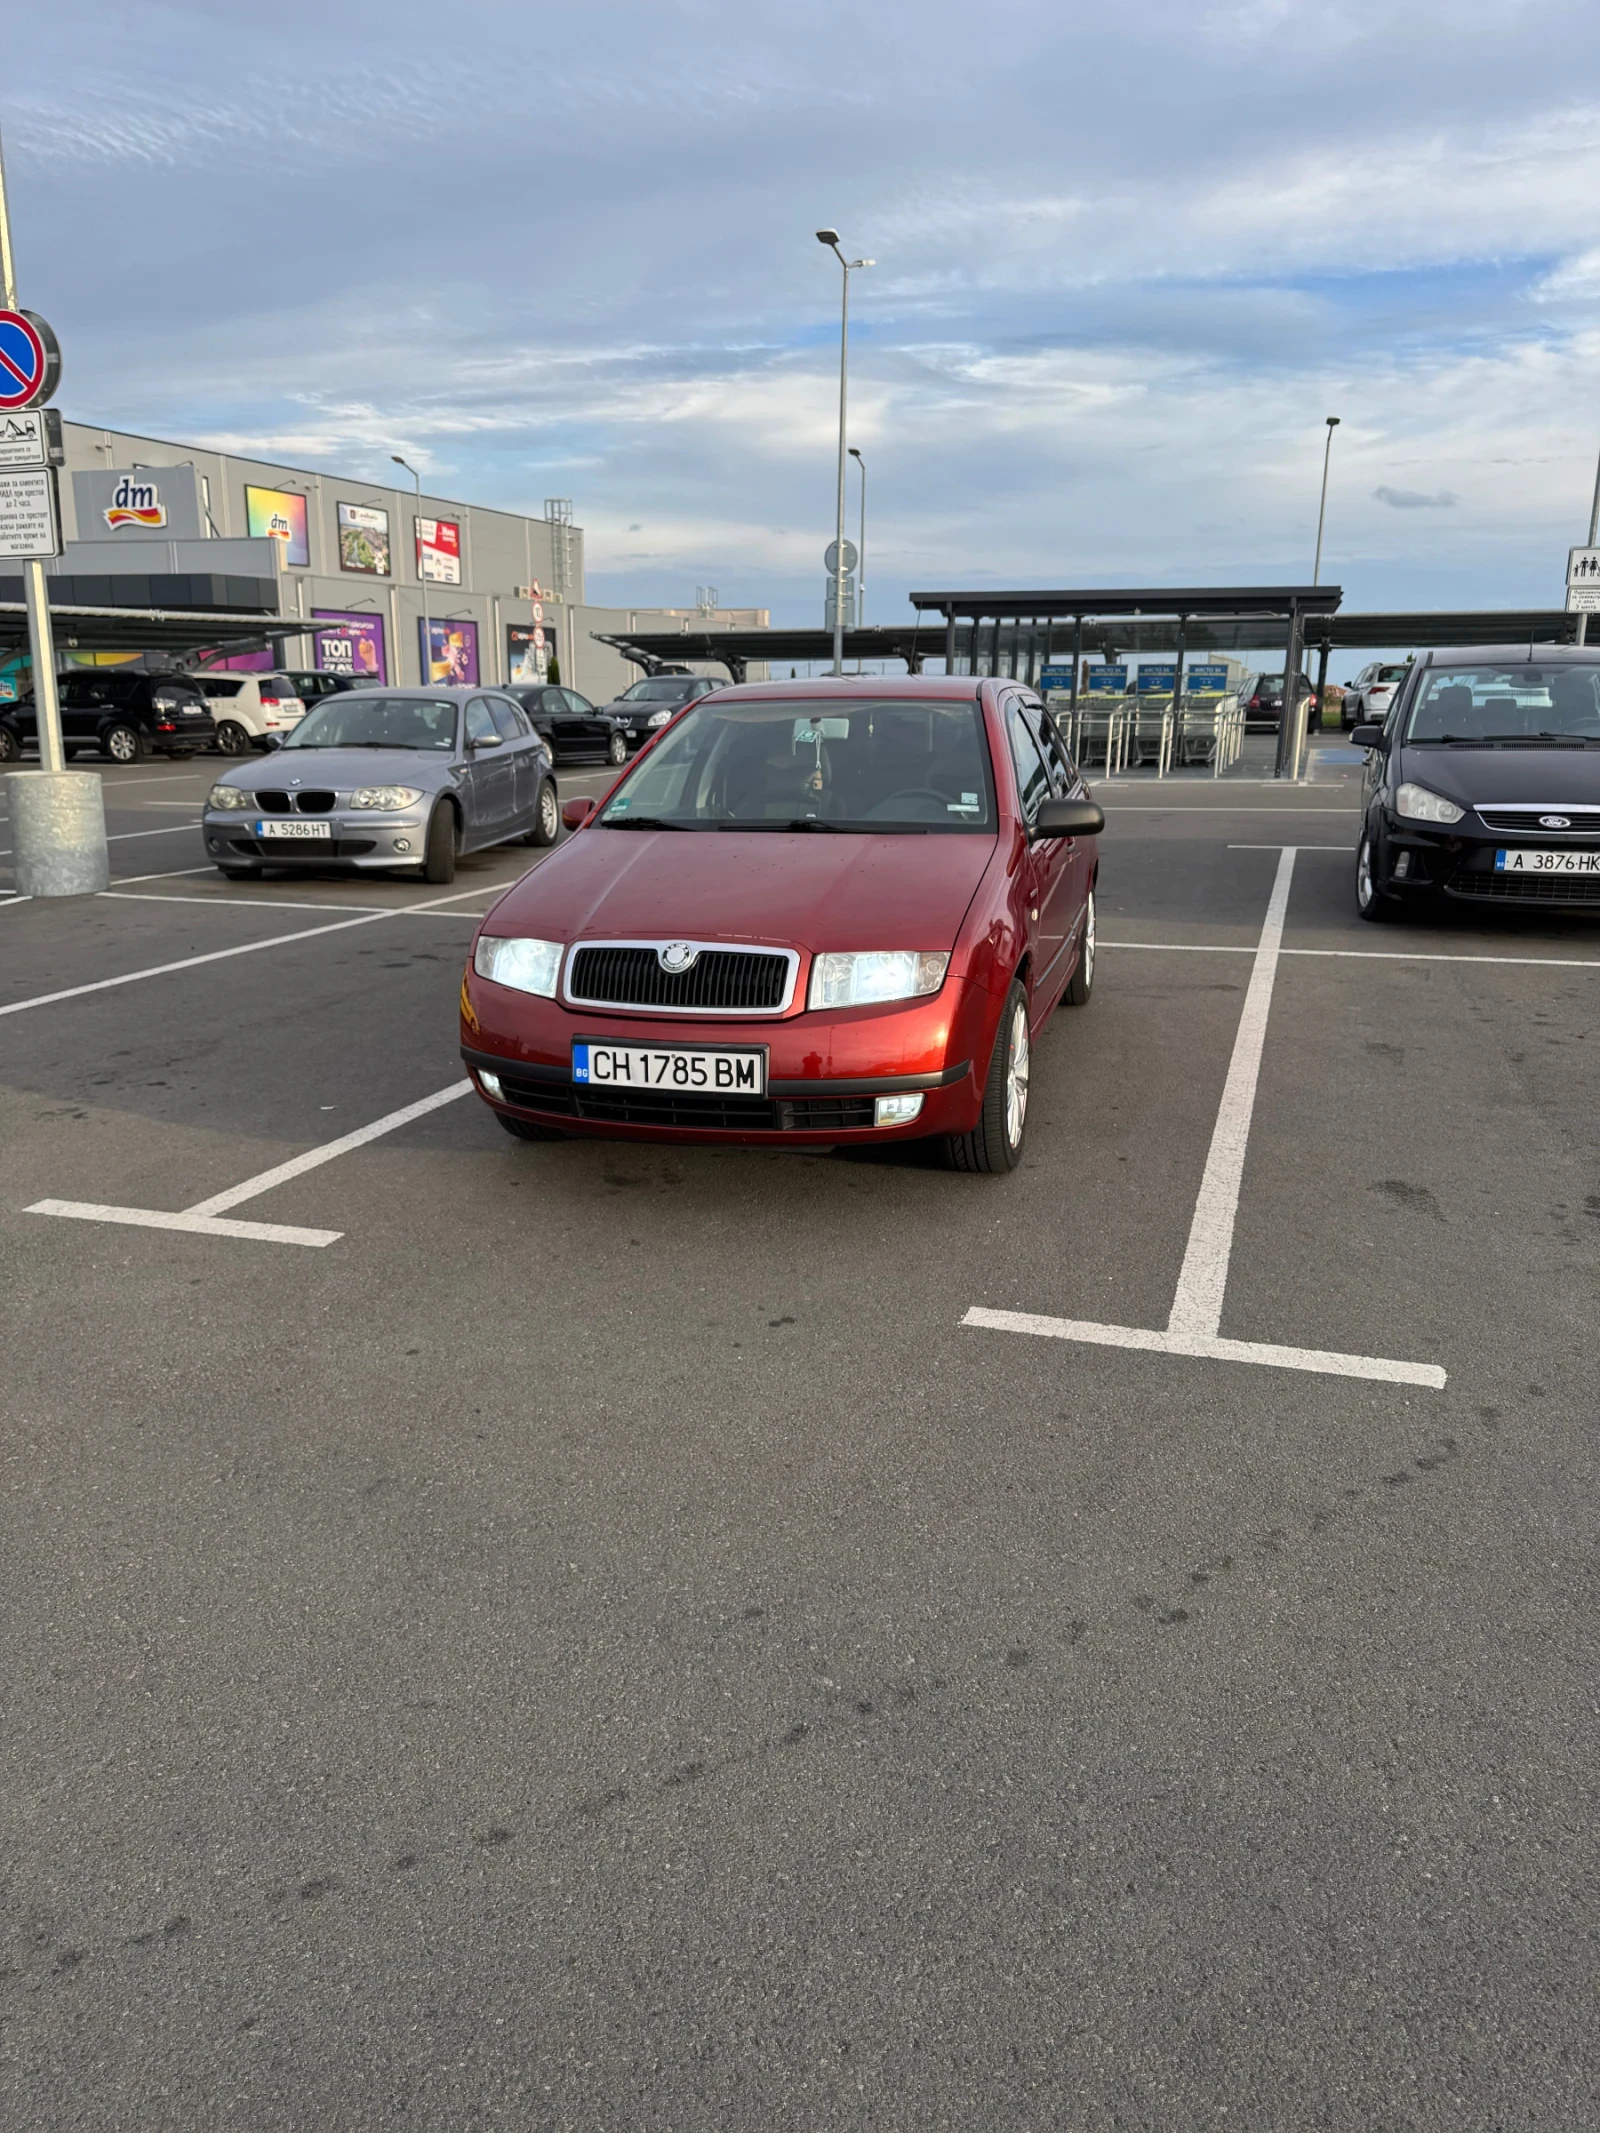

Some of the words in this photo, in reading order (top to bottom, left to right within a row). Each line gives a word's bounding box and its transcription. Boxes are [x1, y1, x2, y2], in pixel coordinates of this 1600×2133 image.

[115, 479, 153, 508] dm
[13, 499, 18, 508] 2
[271, 513, 288, 530] dm
[321, 639, 352, 657] ТОП
[269, 824, 275, 836] A
[281, 823, 310, 836] 5286
[312, 824, 327, 836] HT
[1513, 853, 1523, 868] A
[1533, 854, 1575, 870] 3876
[1578, 855, 1600, 871] HK
[576, 1068, 588, 1077] BG
[594, 1051, 631, 1080] CH
[640, 1054, 708, 1086] 1785
[715, 1058, 755, 1089] BM
